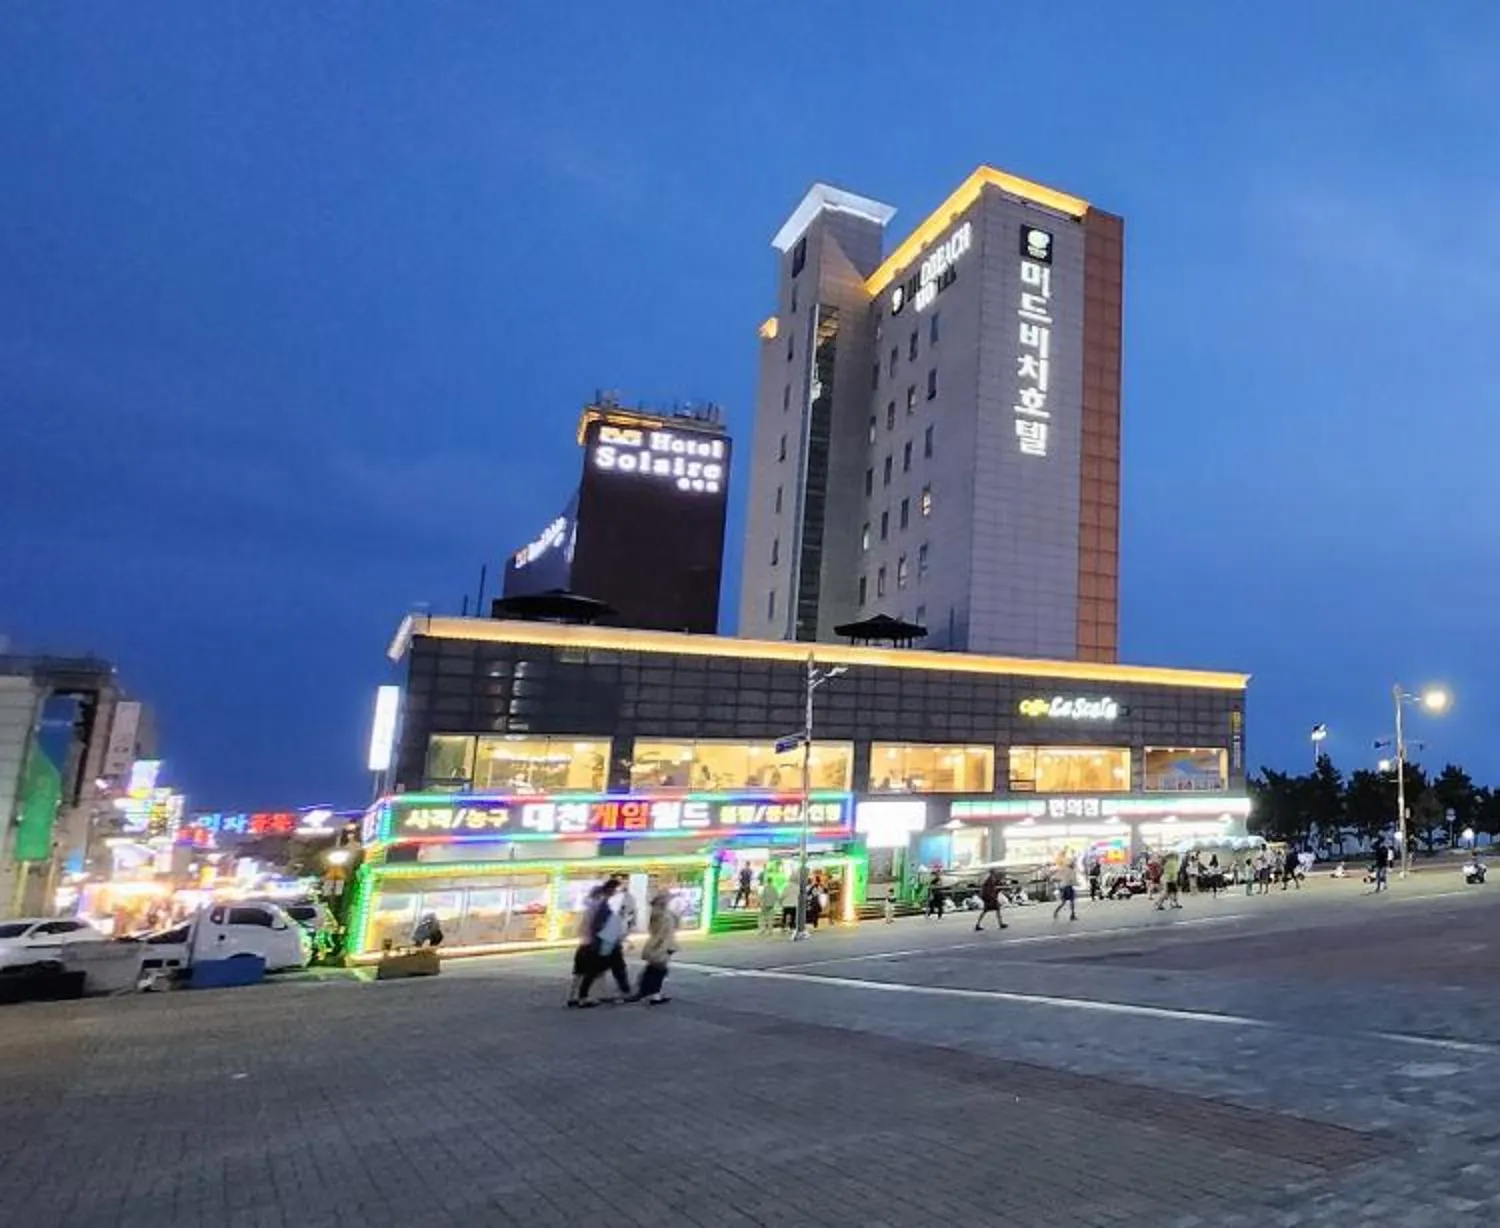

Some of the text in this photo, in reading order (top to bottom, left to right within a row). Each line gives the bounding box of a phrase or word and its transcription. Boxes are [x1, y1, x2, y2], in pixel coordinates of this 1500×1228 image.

[1013, 260, 1053, 457] 미드비치호텔
[650, 432, 724, 458] Hotel
[596, 446, 722, 480] Solaire
[521, 802, 711, 832] 대천게임월드
[1048, 799, 1099, 818] 편의점
